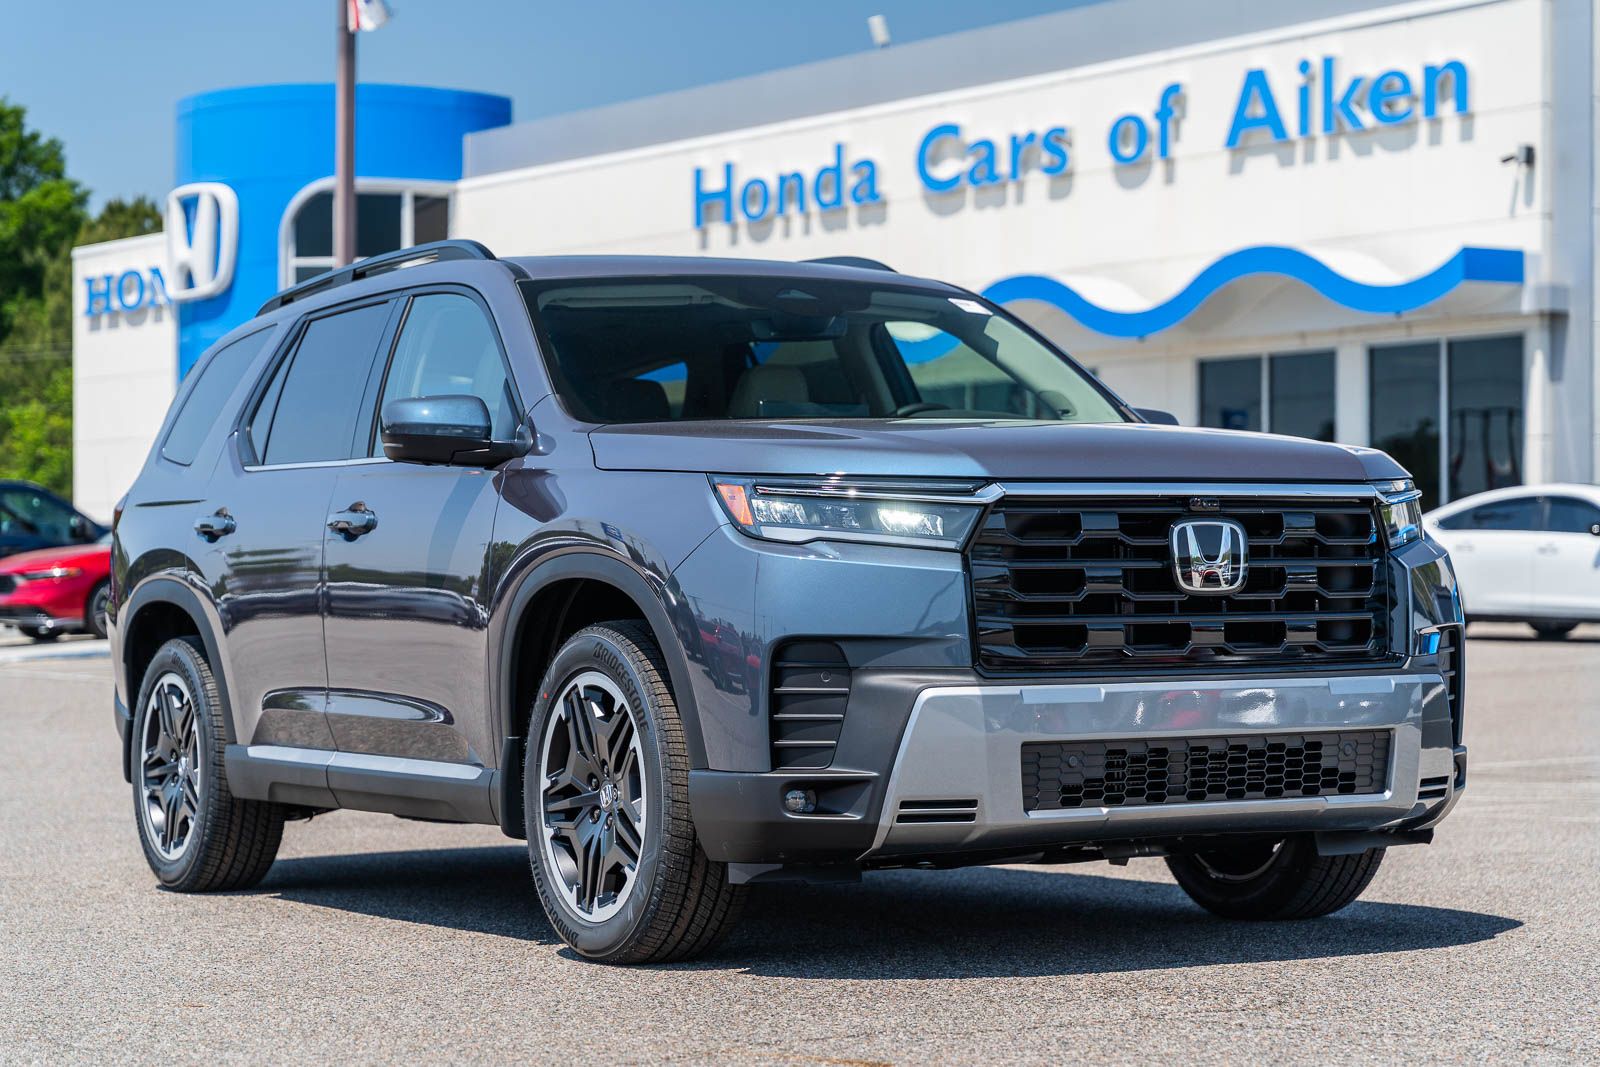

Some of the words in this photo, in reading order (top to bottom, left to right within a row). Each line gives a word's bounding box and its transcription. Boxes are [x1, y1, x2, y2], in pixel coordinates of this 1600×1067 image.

[694, 143, 881, 230] Honda
[915, 123, 1069, 194] Cars
[1108, 83, 1183, 165] of
[1225, 56, 1470, 150] Aiken
[593, 642, 649, 731] BRIDGESTONE
